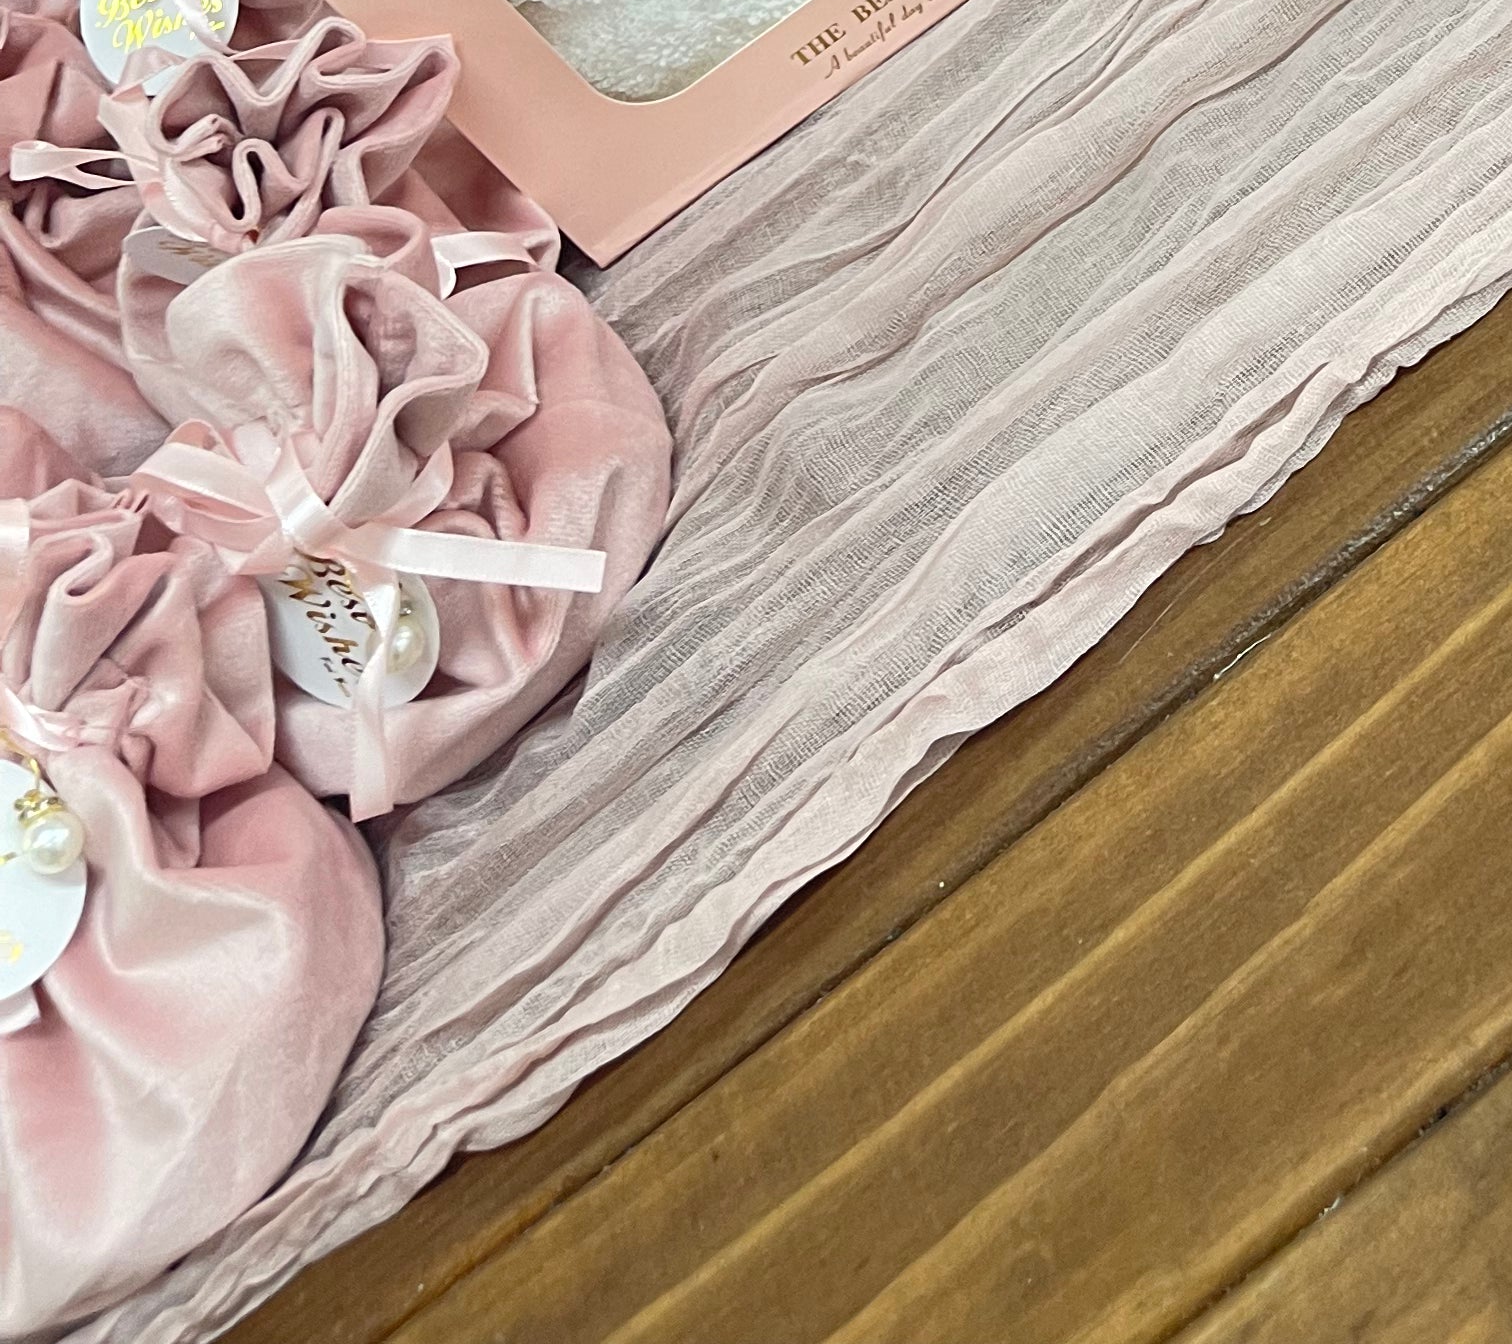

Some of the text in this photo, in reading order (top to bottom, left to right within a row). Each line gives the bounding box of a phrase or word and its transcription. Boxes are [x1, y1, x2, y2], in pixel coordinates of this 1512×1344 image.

[790, 22, 847, 67] THE
[823, 54, 841, 80] A
[845, 13, 896, 62] beautiful
[901, 3, 924, 22] day
[276, 565, 364, 678] Wishe
